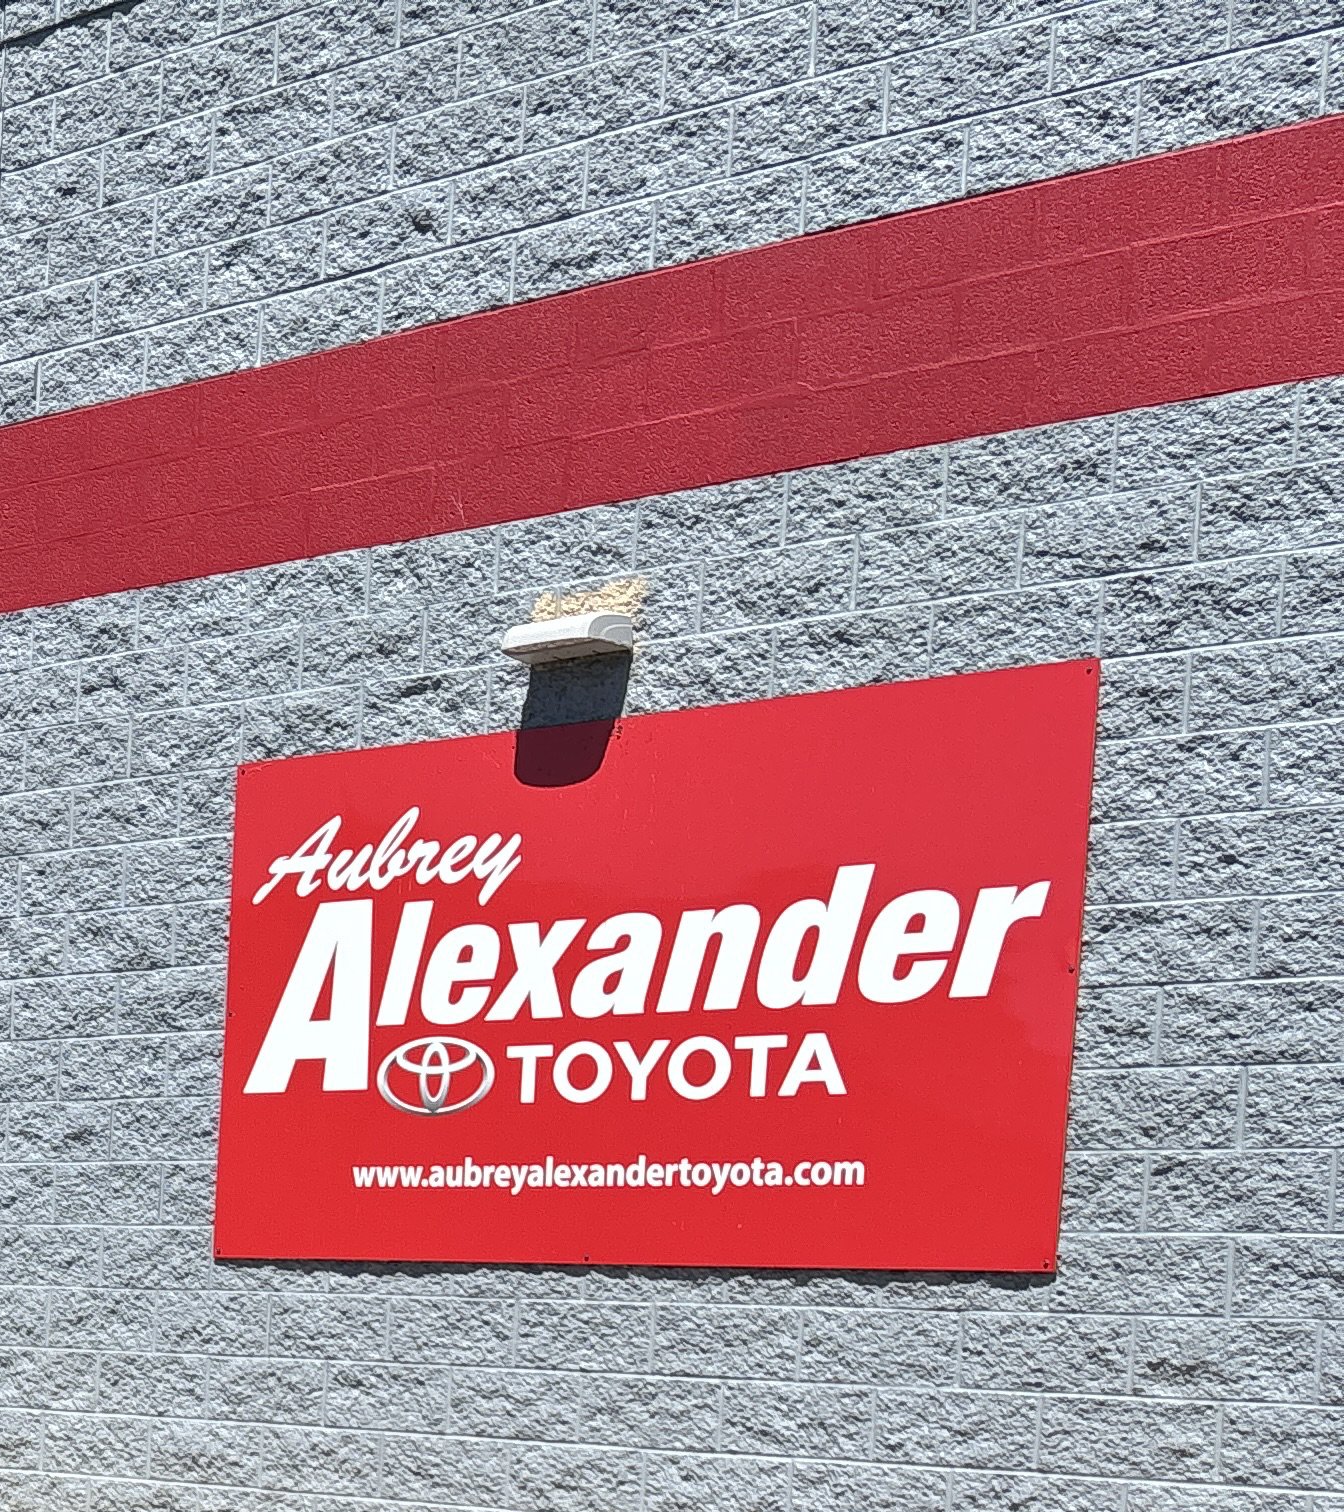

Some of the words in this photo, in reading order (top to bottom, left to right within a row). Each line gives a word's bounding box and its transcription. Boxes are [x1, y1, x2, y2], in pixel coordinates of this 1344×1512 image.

[253, 806, 522, 906] Aubrey
[243, 864, 1051, 1094] Alexander
[506, 1033, 847, 1104] TOYOTA
[352, 1154, 865, 1196] www.aubreyalexandertoyota.com
